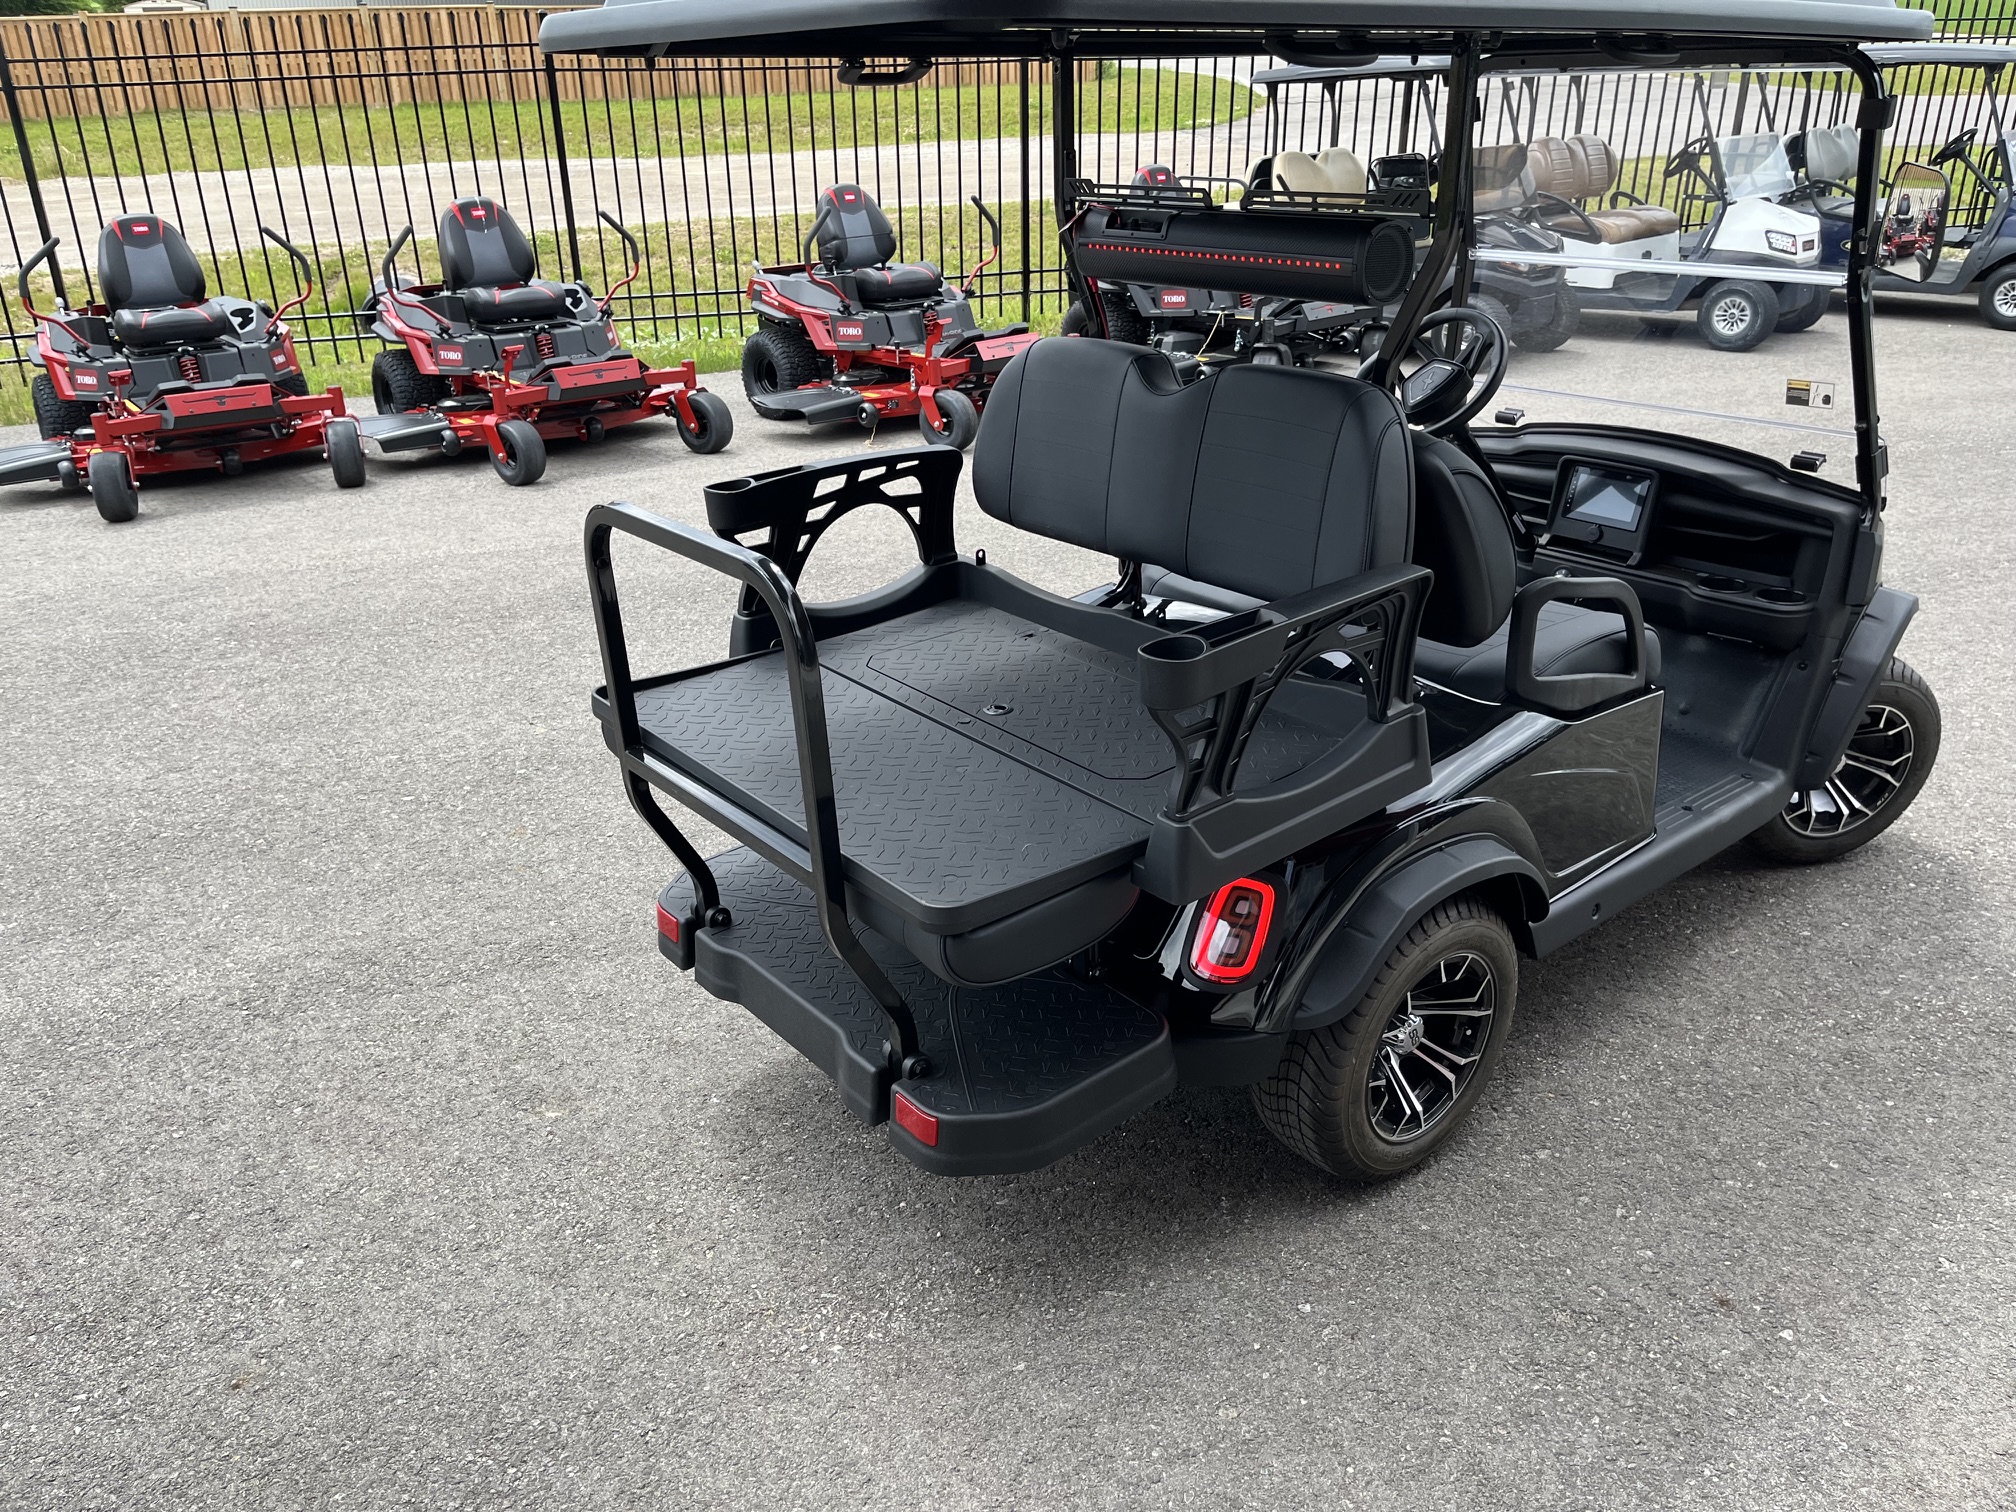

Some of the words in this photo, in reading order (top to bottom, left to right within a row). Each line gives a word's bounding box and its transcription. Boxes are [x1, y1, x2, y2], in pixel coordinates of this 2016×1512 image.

[1163, 295, 1186, 303] TORO
[838, 327, 862, 336] TORO
[439, 350, 462, 360] TORO
[75, 374, 98, 385] TORO
